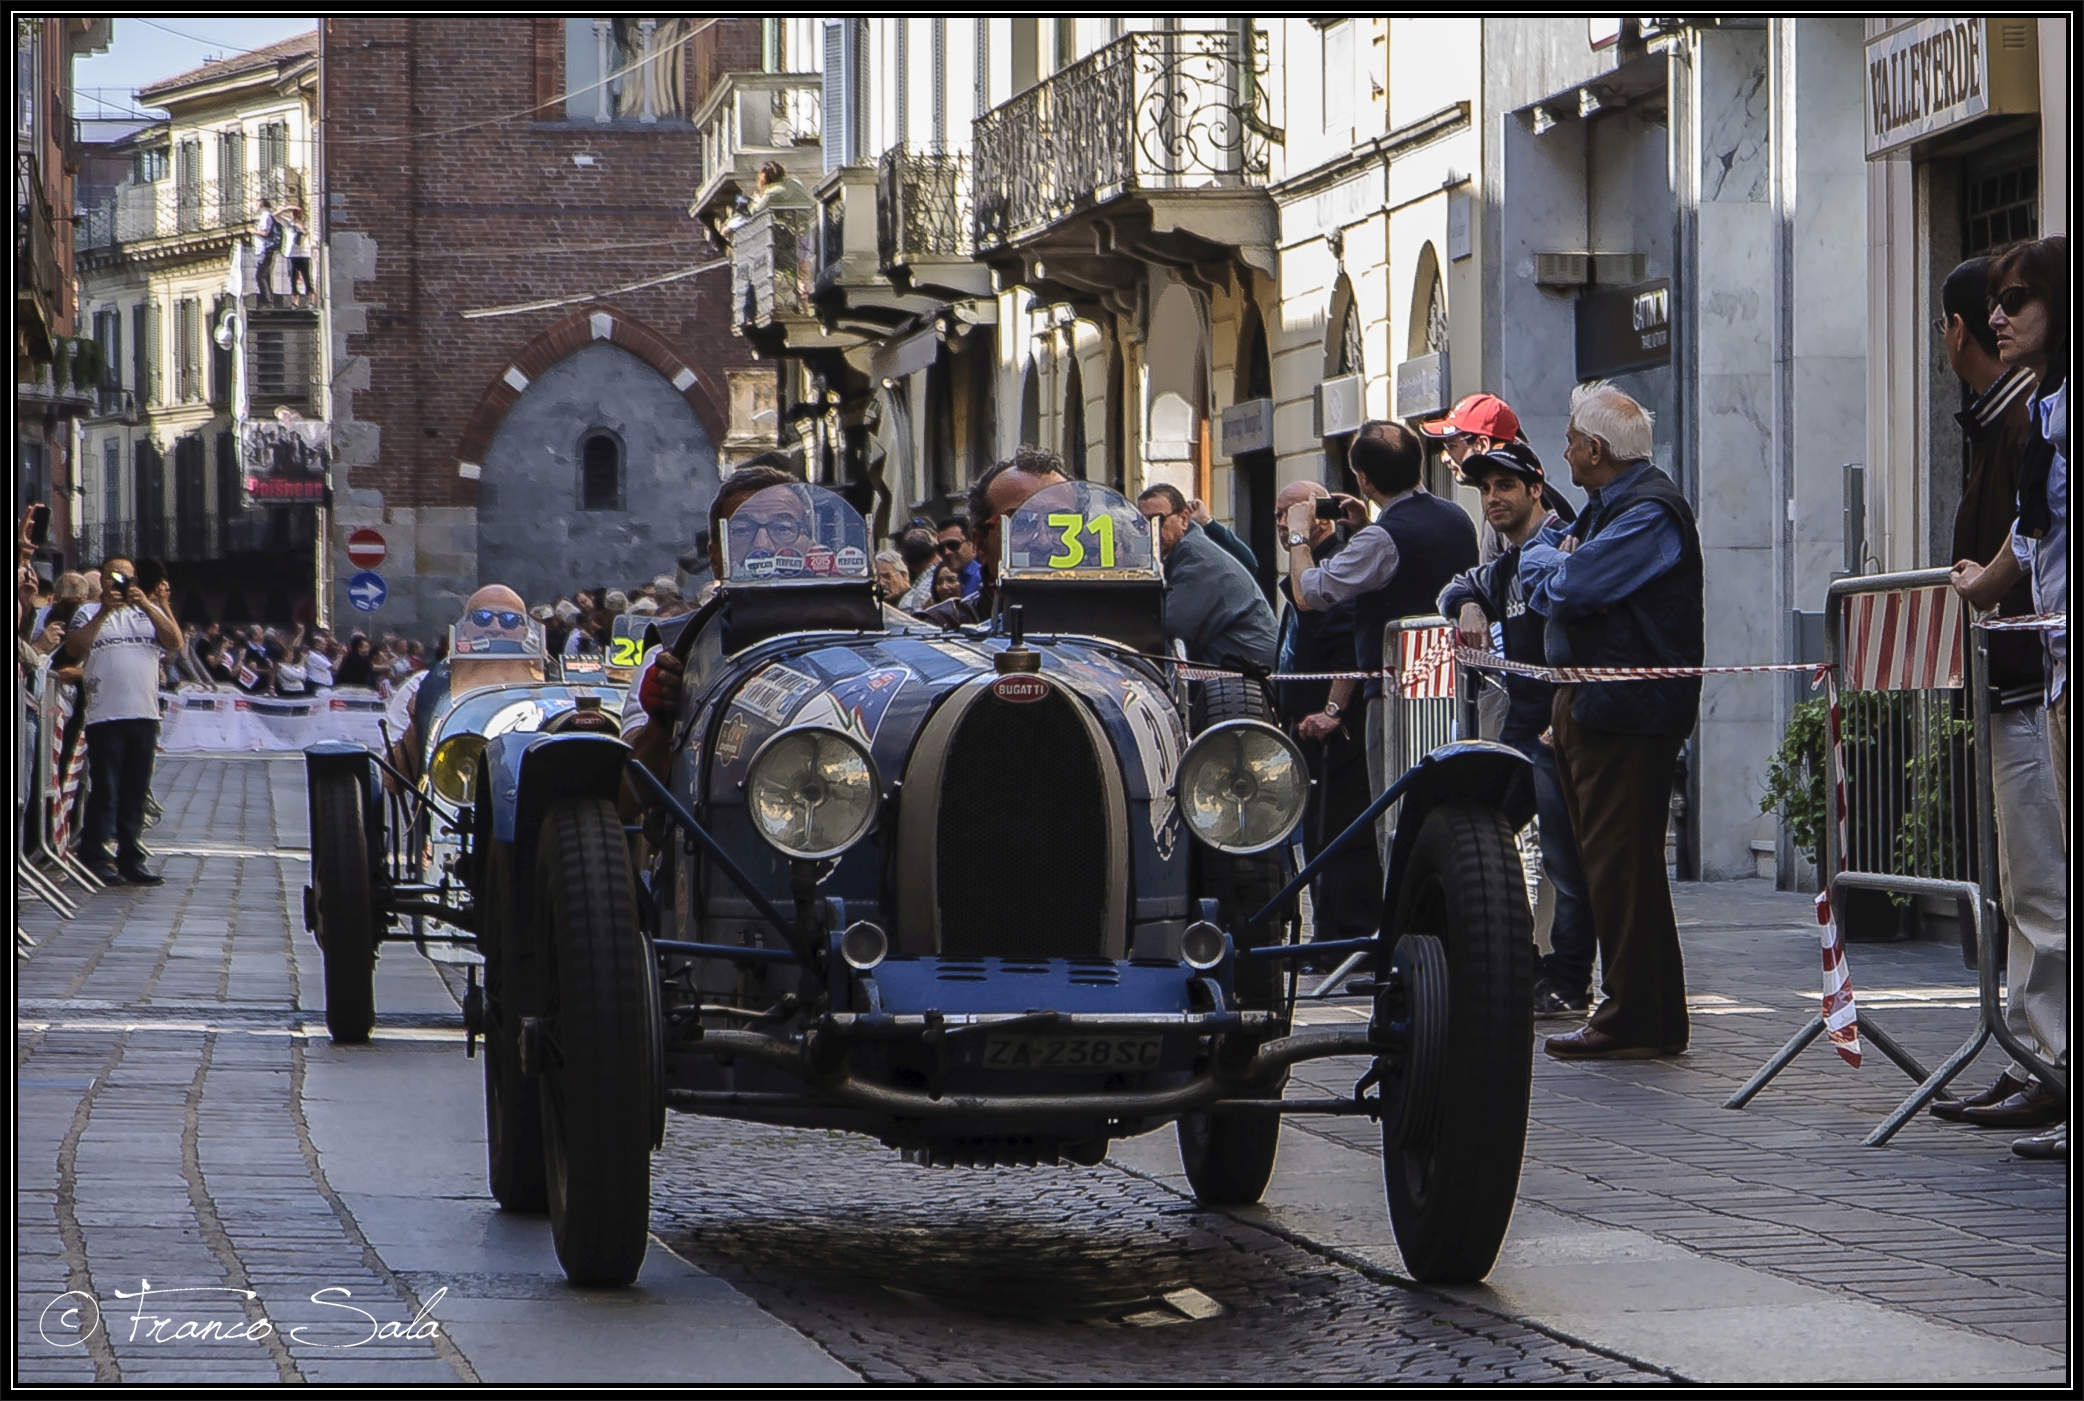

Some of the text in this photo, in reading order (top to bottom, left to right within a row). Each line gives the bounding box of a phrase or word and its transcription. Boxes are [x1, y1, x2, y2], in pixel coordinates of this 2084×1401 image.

[1870, 18, 1981, 135] VALLEVERDE
[1047, 513, 1115, 568] 31
[811, 557, 831, 566] 2015
[91, 636, 158, 650] MANCHESTE
[999, 684, 1044, 695] BUGATTI
